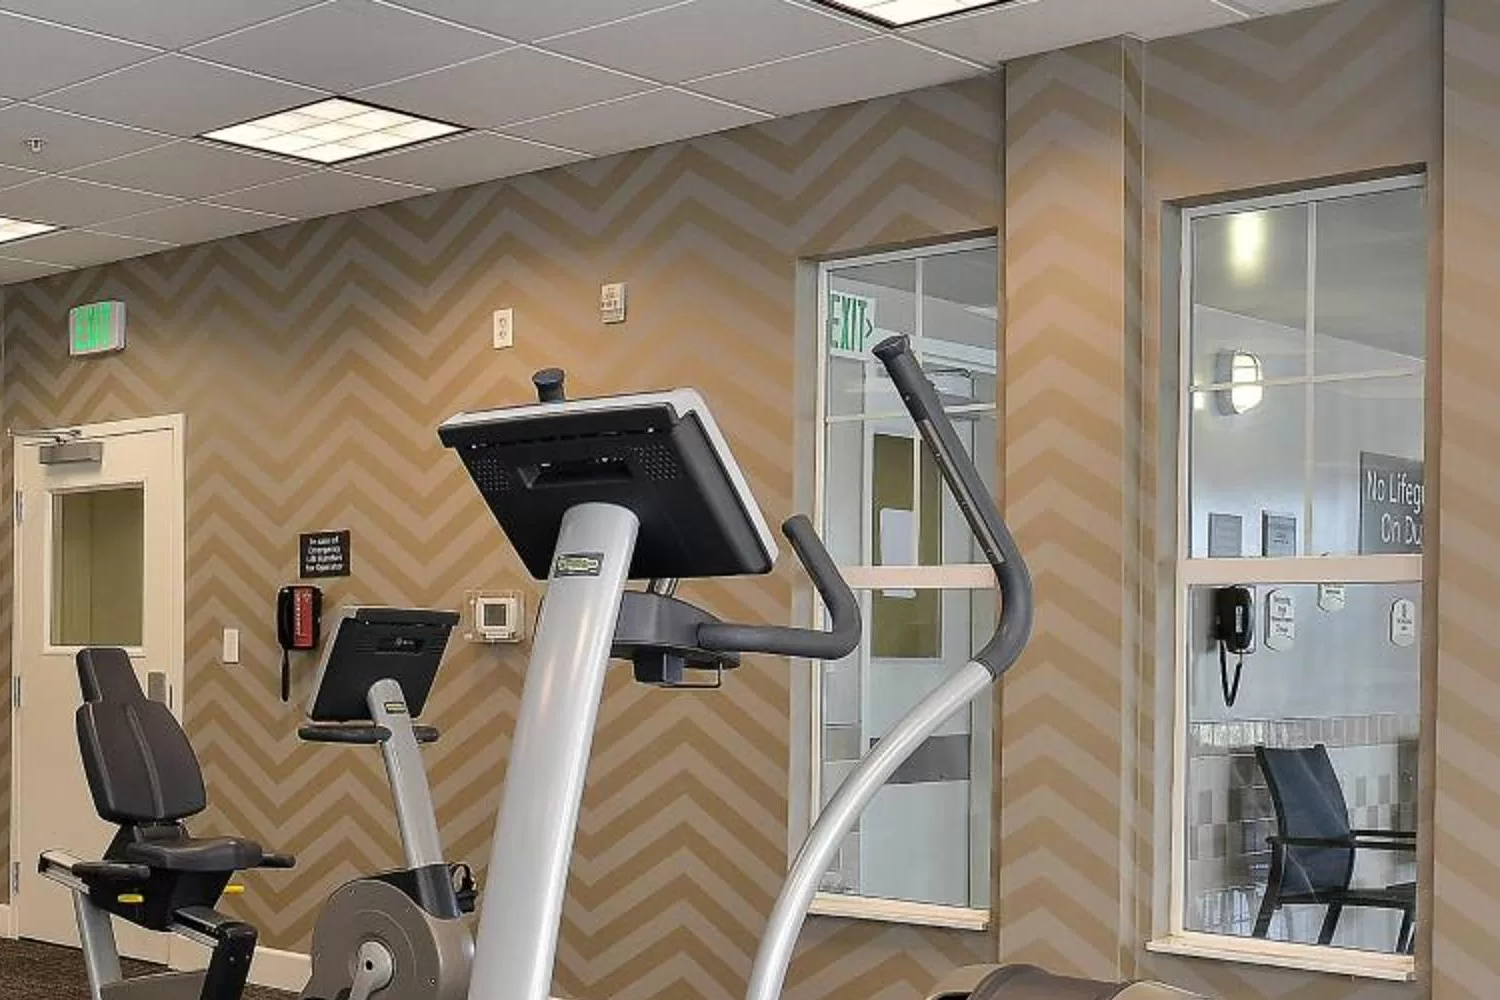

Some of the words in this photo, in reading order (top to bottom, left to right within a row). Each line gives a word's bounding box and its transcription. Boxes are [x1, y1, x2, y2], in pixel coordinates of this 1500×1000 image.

[830, 294, 868, 352] EXIT
[1367, 470, 1385, 501] No
[1381, 512, 1401, 543] On
